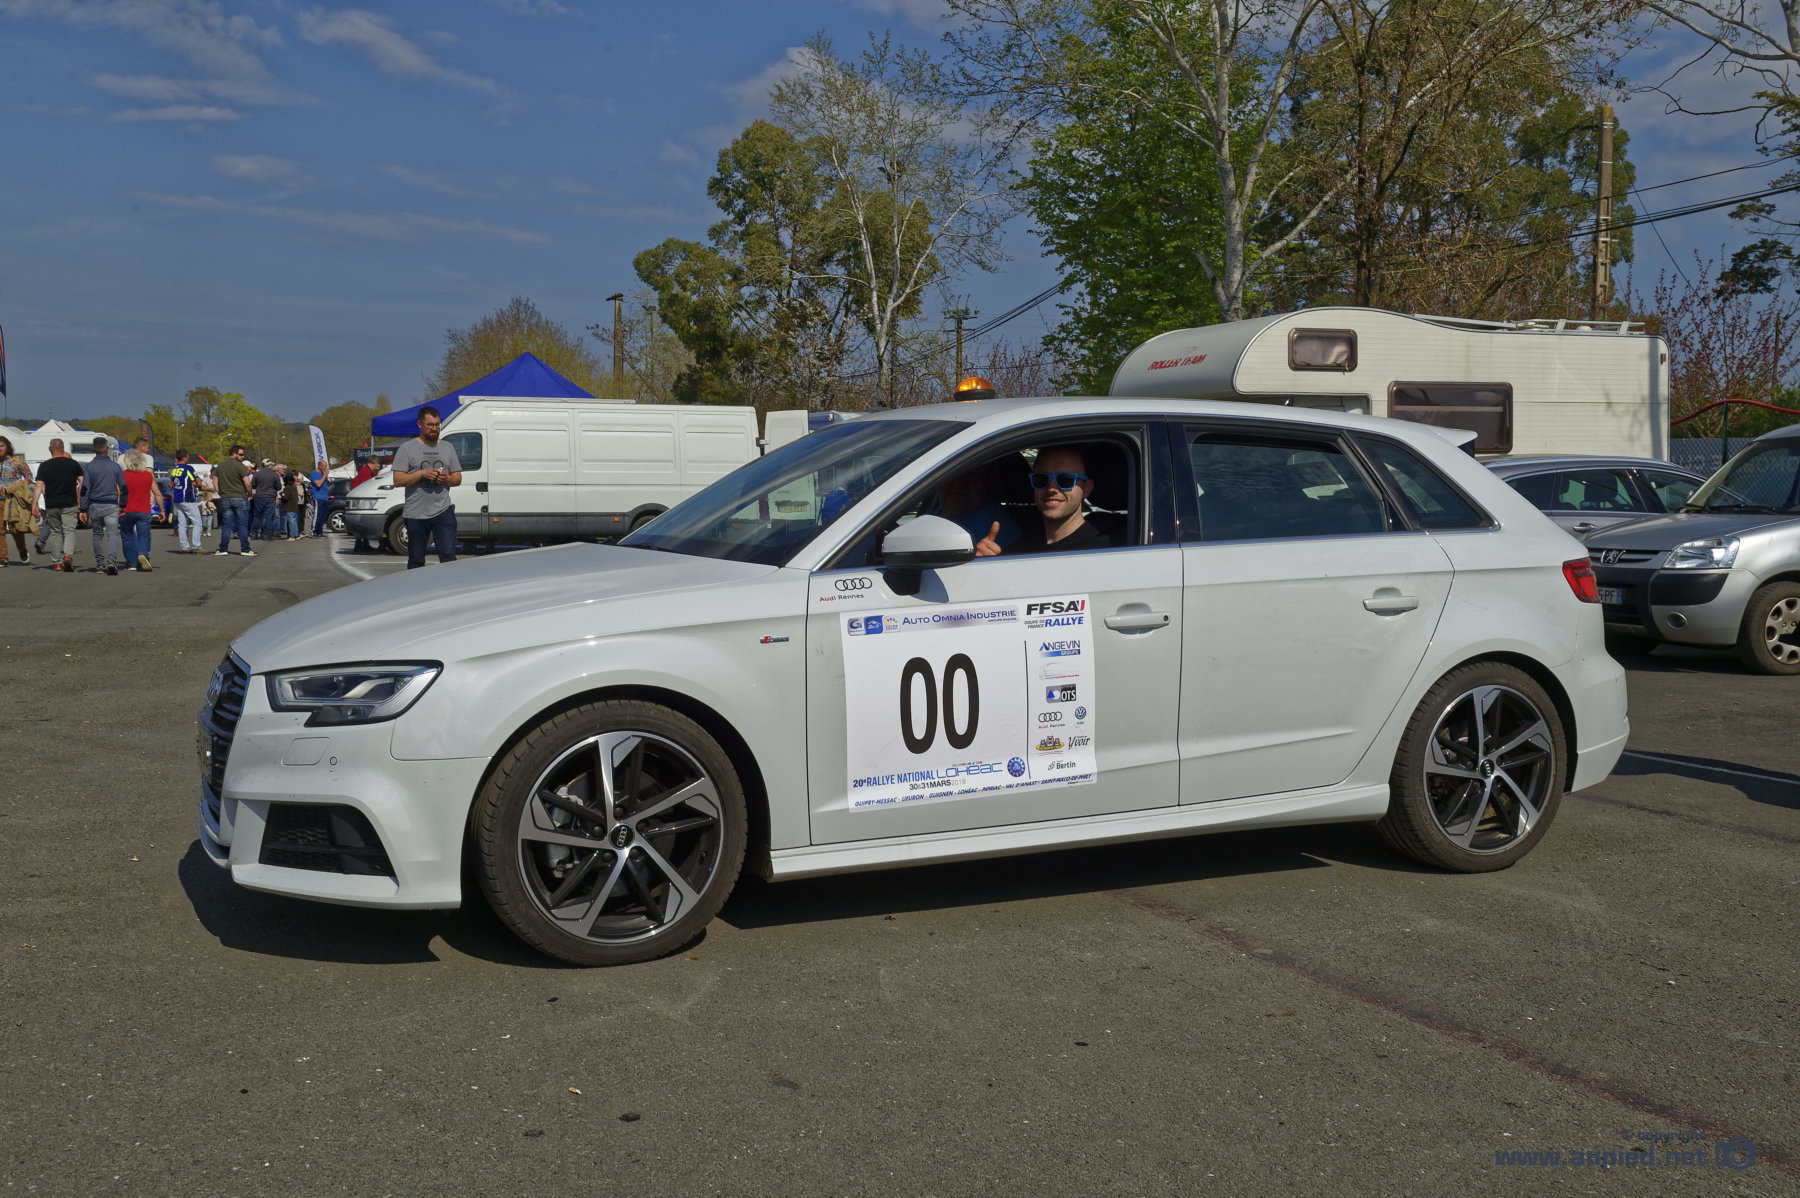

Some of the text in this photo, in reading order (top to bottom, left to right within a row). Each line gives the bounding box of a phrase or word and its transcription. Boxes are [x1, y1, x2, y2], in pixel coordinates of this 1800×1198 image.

[1026, 600, 1081, 616] FFSA
[1045, 616, 1084, 628] RALLYE
[1039, 640, 1081, 651] ANGEVIN
[1061, 690, 1076, 701] OTS
[900, 653, 980, 754] 00
[866, 775, 895, 787] RALLYE
[897, 769, 936, 784] NATIONAL
